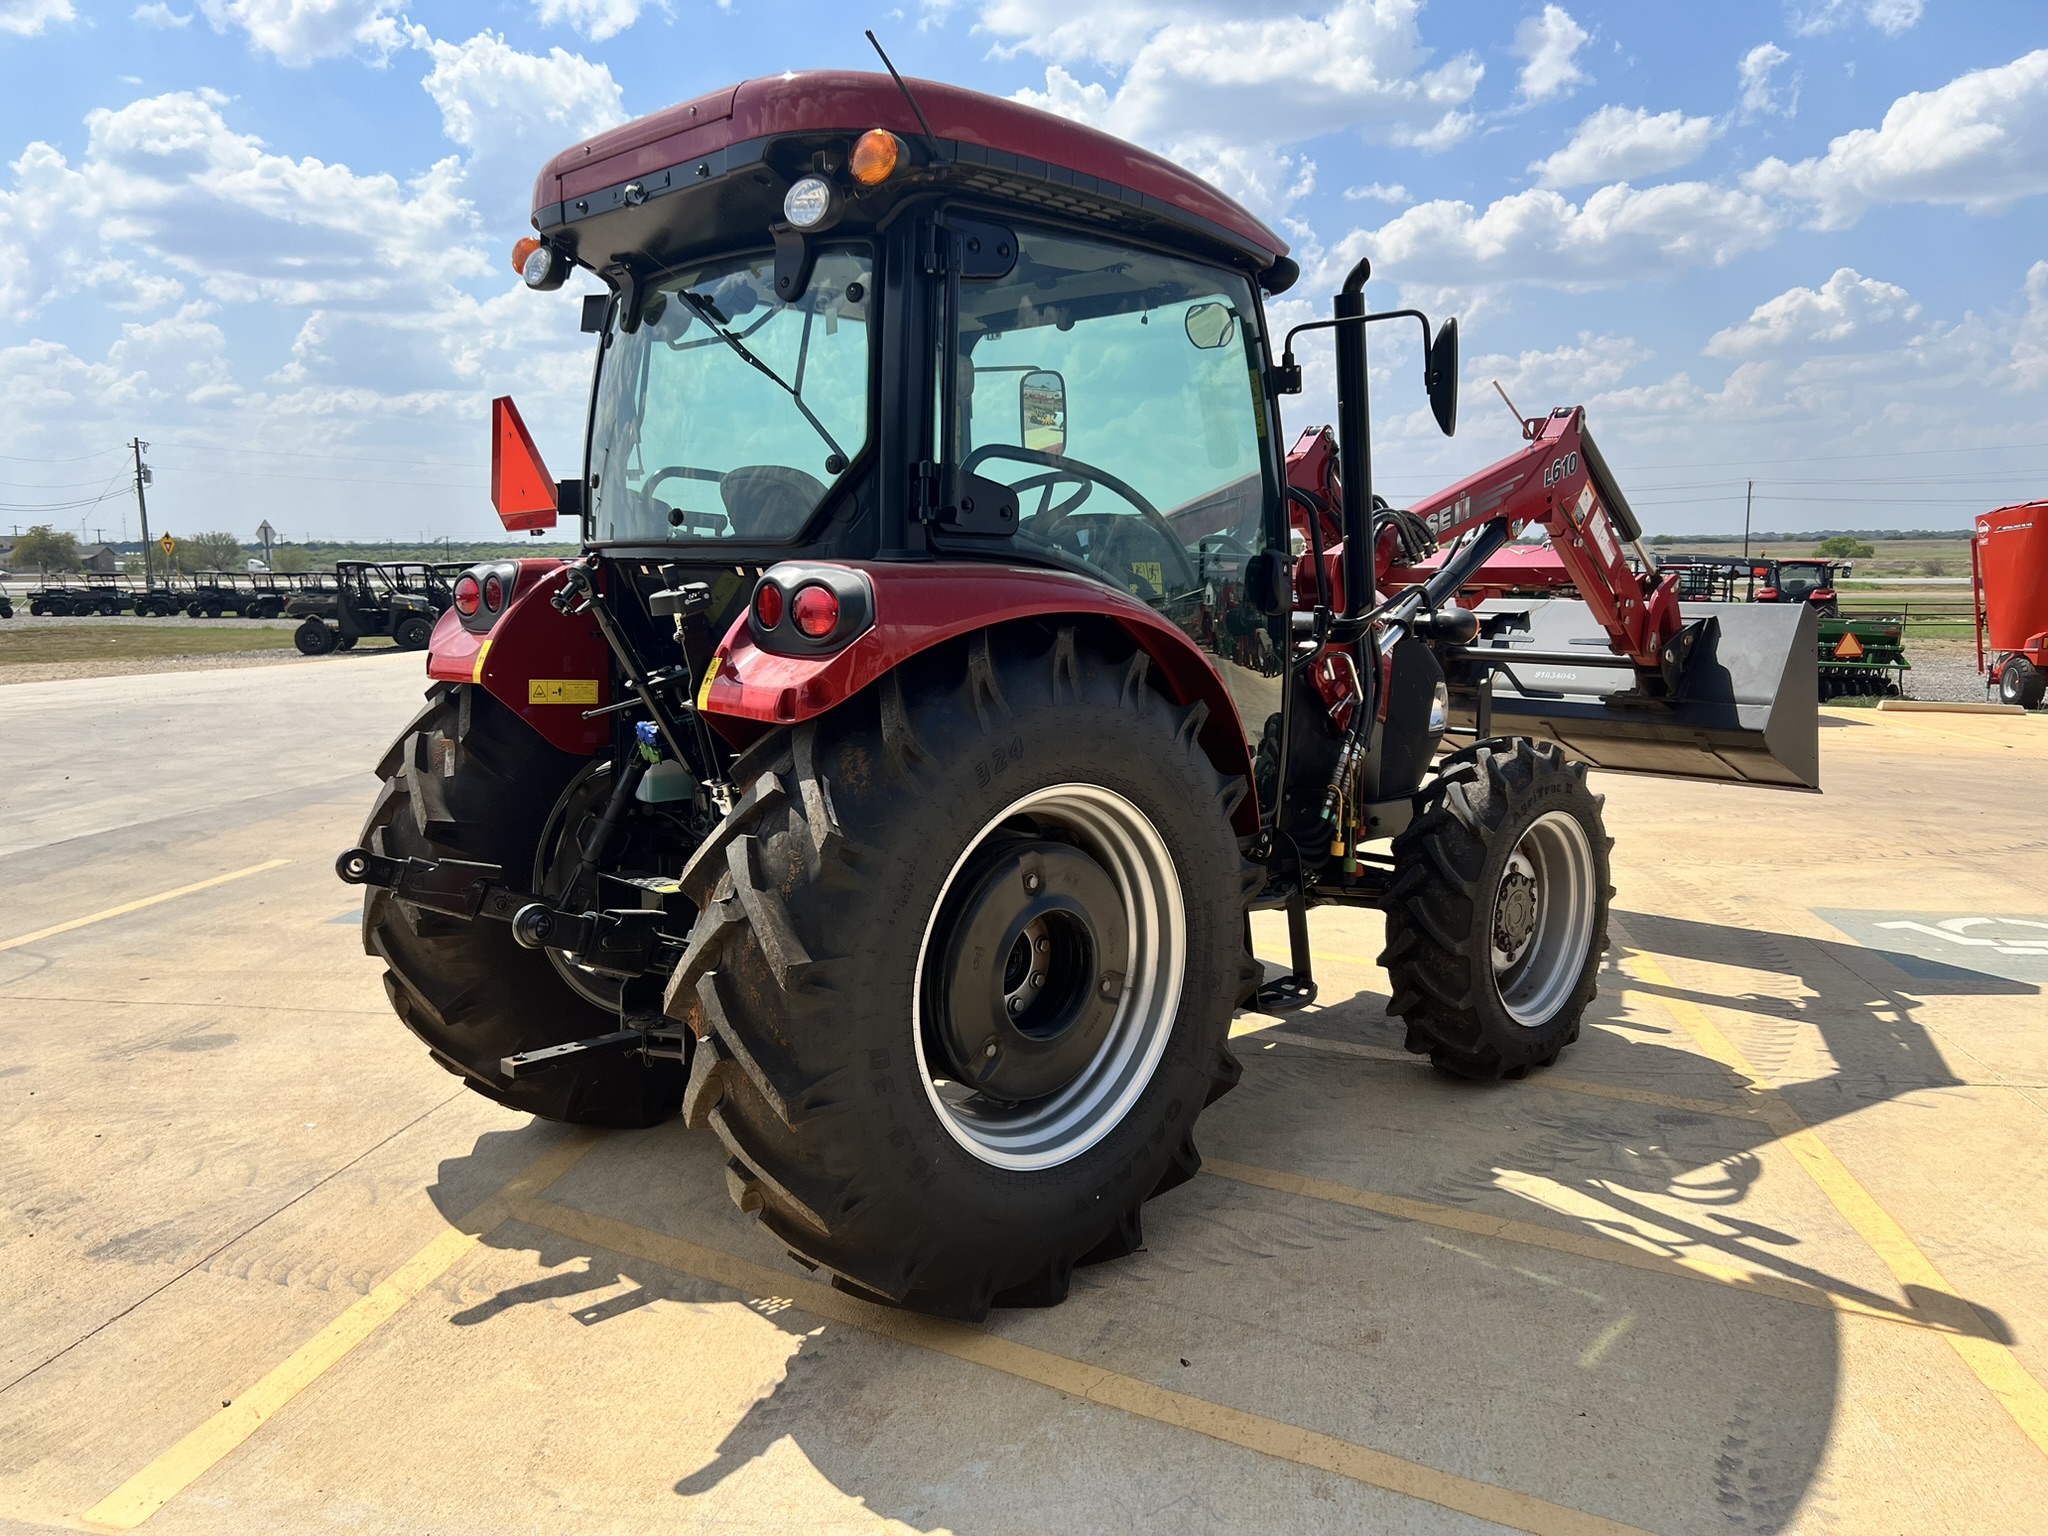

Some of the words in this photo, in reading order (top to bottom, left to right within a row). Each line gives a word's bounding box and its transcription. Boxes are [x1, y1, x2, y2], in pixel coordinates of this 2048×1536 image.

[1543, 450, 1577, 488] L610
[1426, 505, 1452, 535] SE
[1512, 783, 1562, 827] AgriTrac
